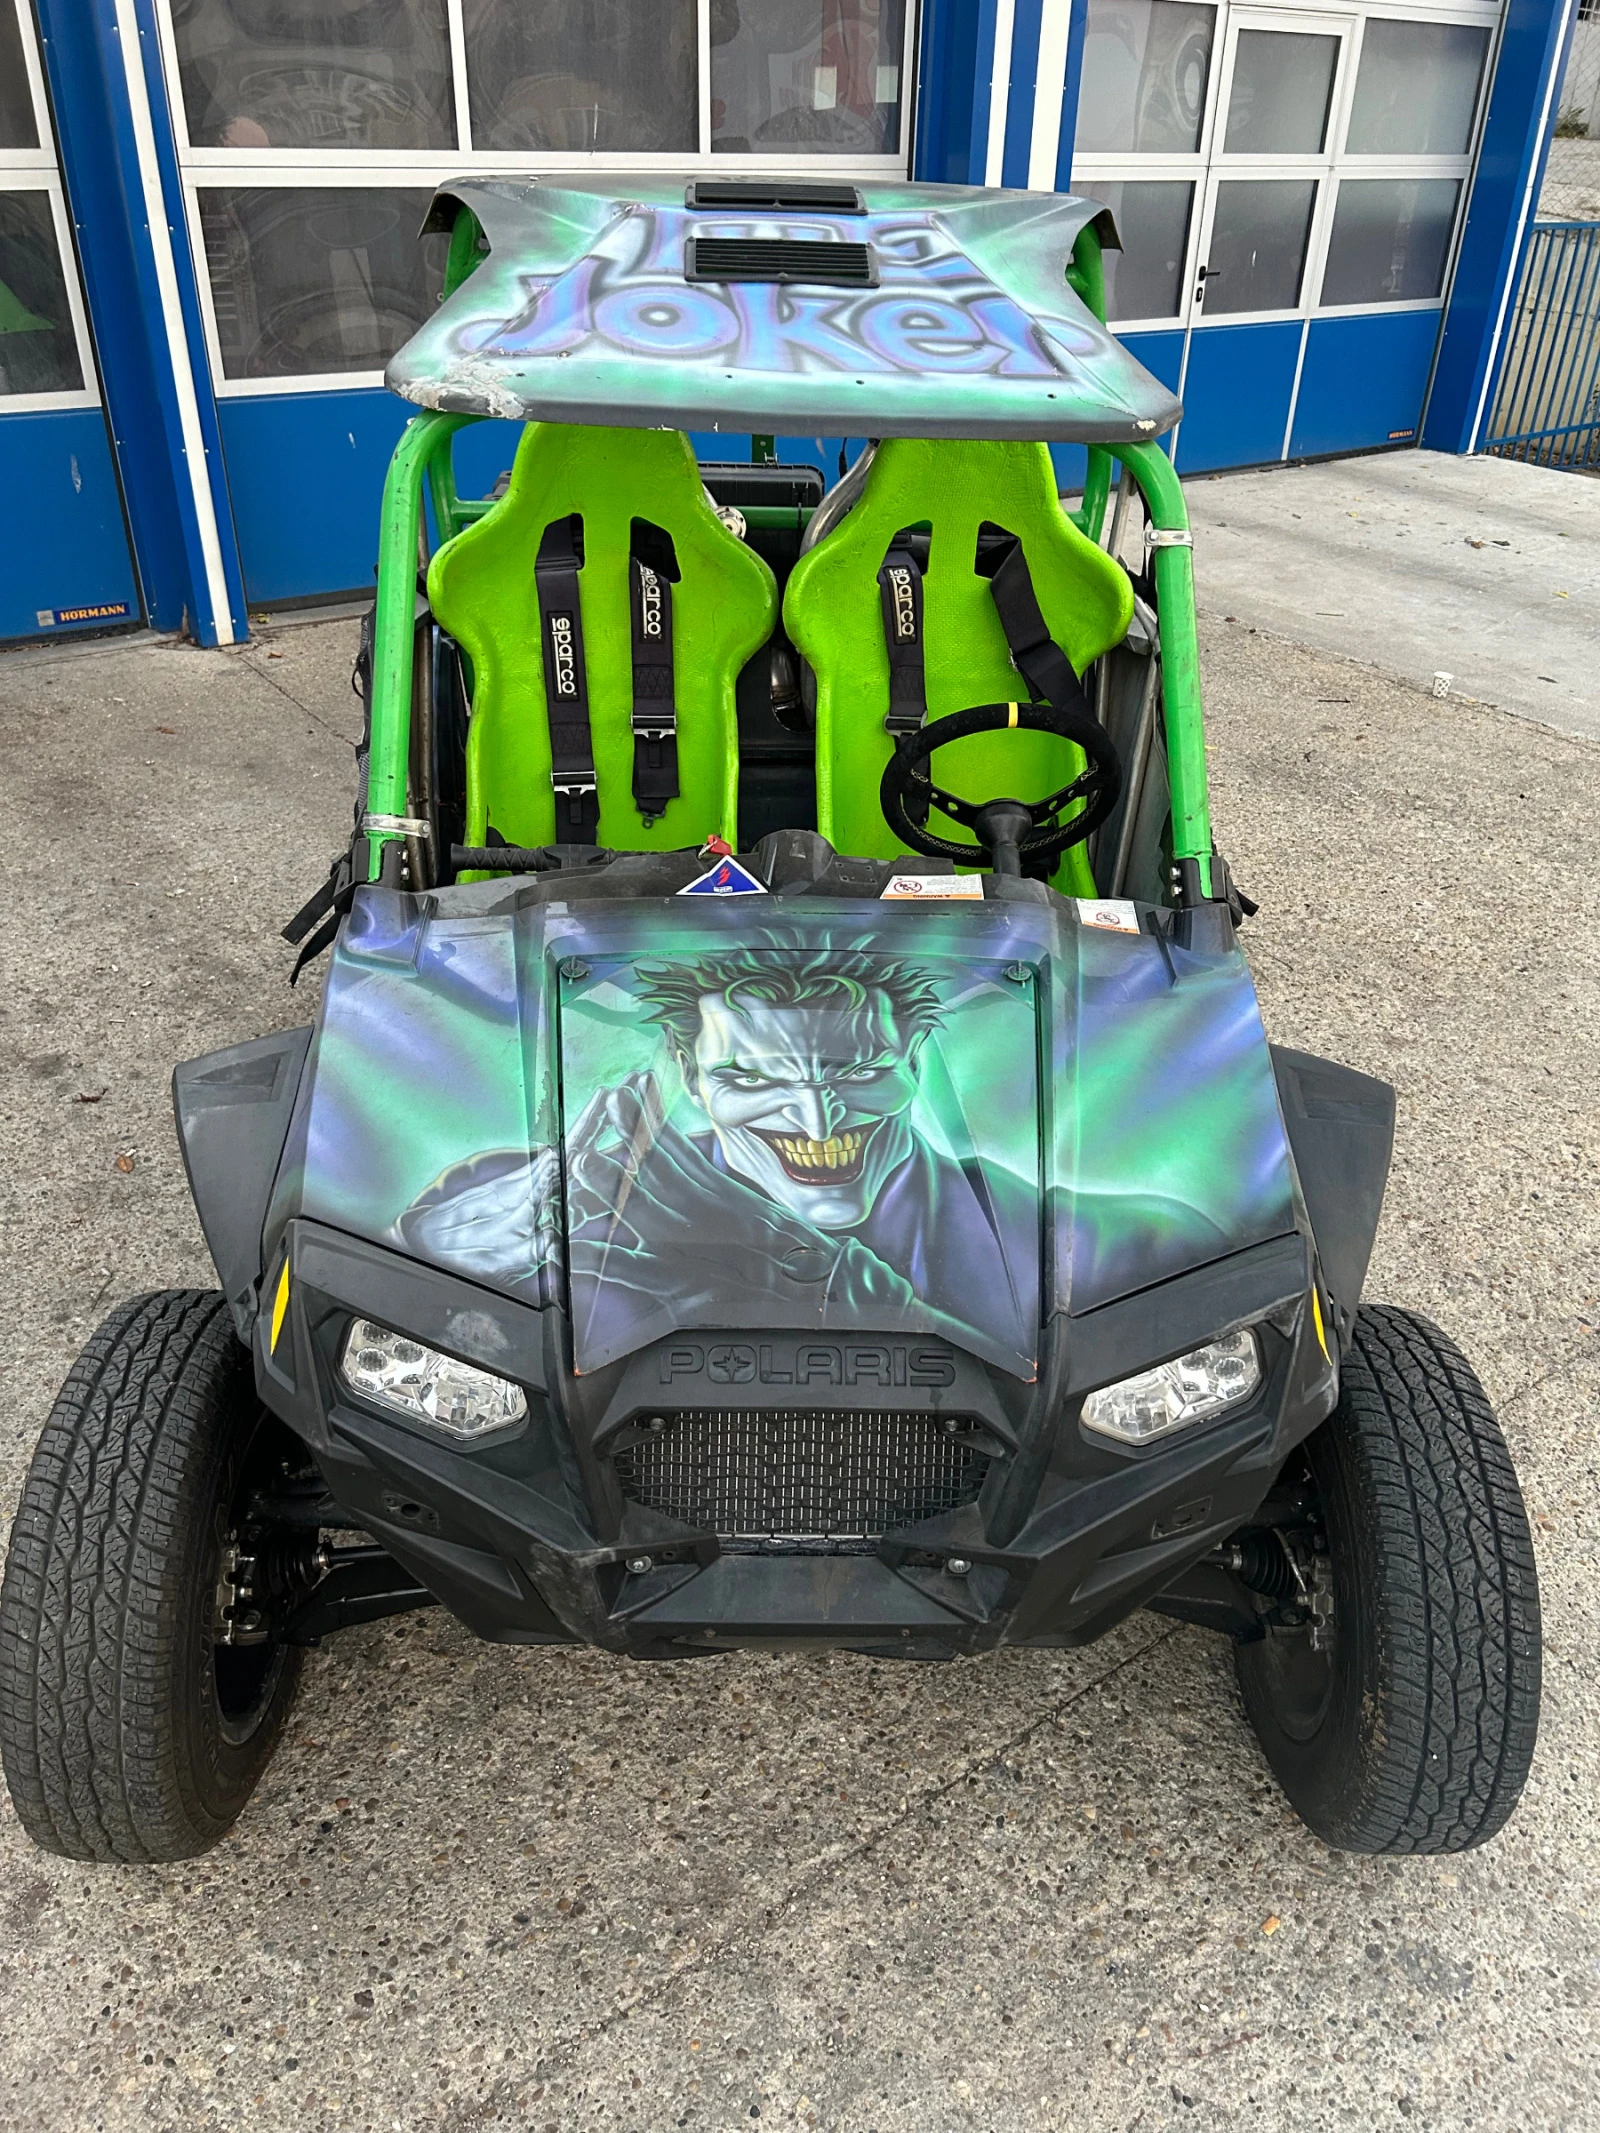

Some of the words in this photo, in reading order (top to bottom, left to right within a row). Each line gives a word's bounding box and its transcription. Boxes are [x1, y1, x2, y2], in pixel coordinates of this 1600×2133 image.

[889, 569, 914, 636] sparco
[552, 617, 576, 695] sparco
[659, 1344, 956, 1387] POLARIS
